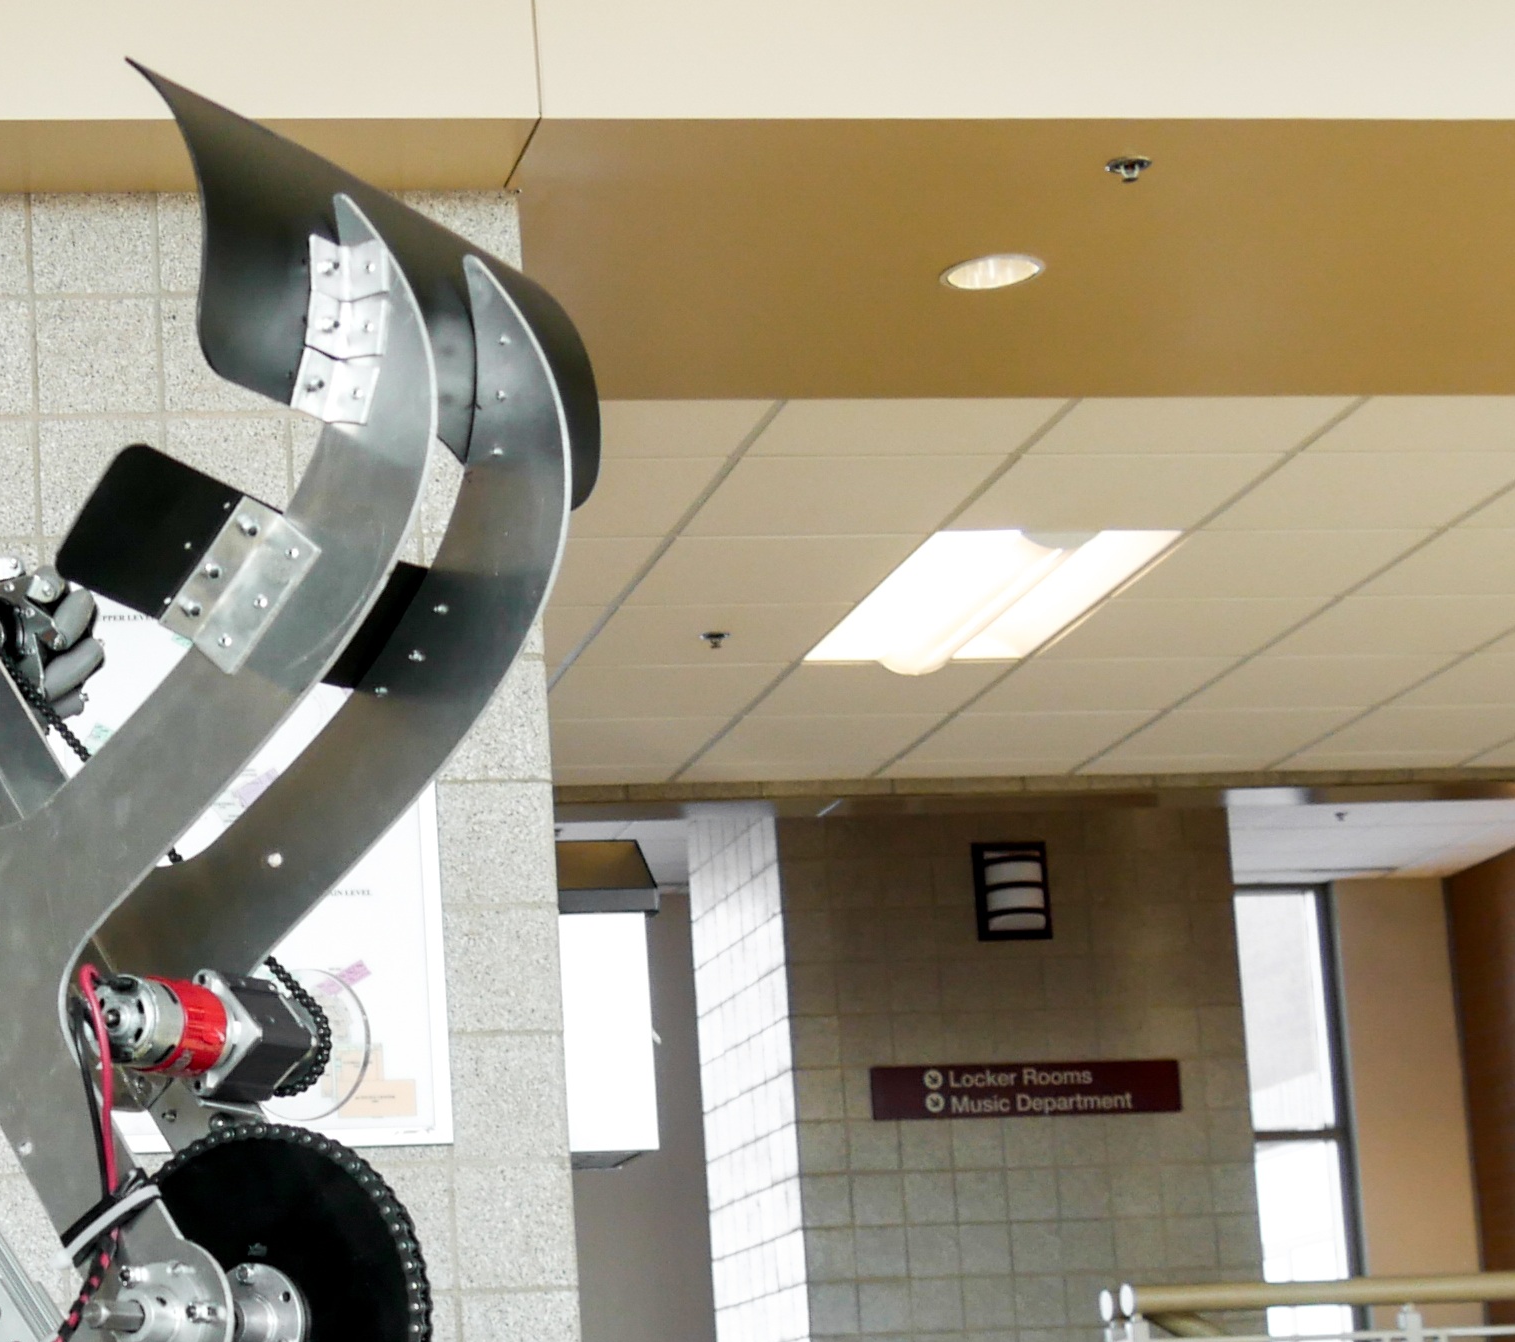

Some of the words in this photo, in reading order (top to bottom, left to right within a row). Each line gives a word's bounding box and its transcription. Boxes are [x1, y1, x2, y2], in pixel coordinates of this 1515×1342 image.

[949, 1069, 1017, 1088] Locker
[1022, 1067, 1093, 1085] Rooms
[950, 1094, 1011, 1113] Music
[1016, 1092, 1133, 1116] Department
